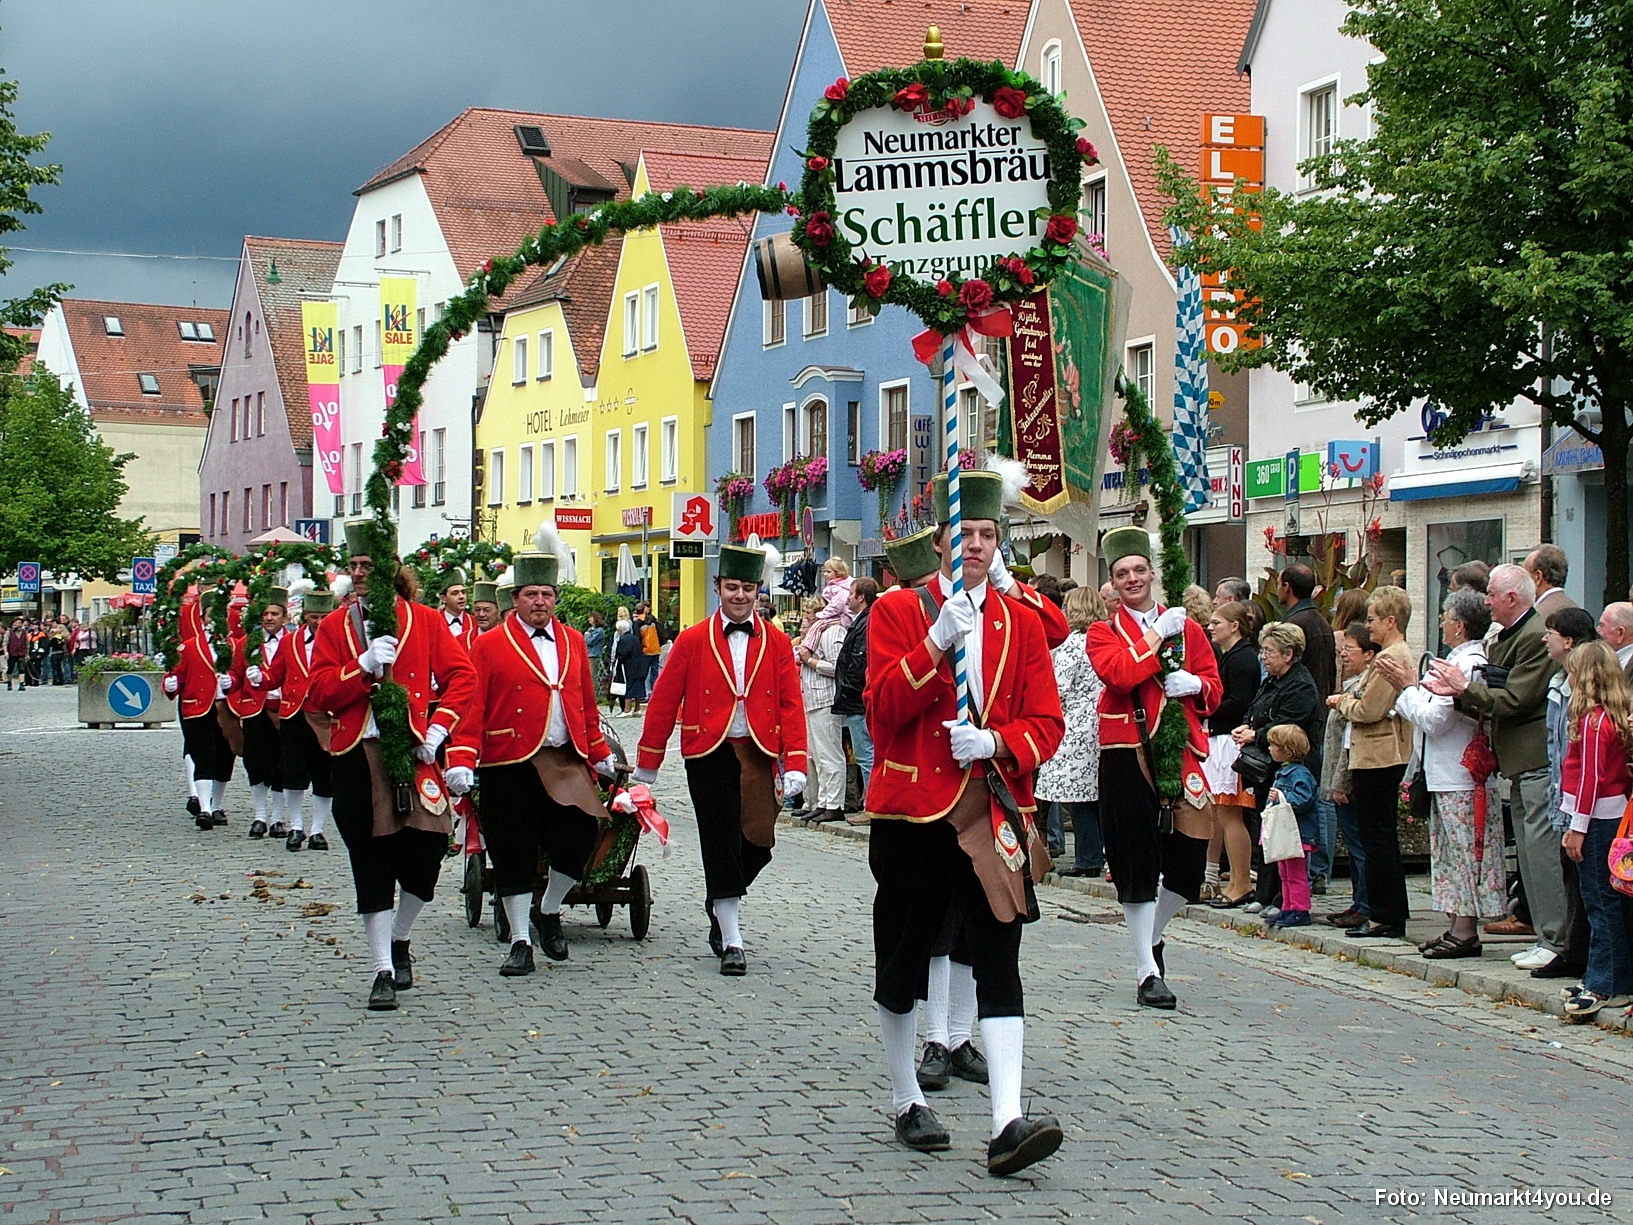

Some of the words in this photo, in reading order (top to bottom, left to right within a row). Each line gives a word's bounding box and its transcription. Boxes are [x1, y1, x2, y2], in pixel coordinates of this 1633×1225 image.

[863, 122, 1022, 155] Neumarkter
[834, 148, 1052, 193] Lammsbräu
[843, 197, 1041, 248] Schäffler
[384, 304, 413, 332] K&L
[384, 332, 413, 345] SALE
[526, 410, 553, 435] HOTEL
[559, 405, 590, 427] Lehmeier
[1433, 444, 1502, 460] Schnäppchenmarkt
[1232, 449, 1241, 518] KINO
[1256, 464, 1270, 485] 360
[556, 514, 592, 524] WISSMACH
[20, 582, 37, 590] TAXI
[135, 582, 154, 591] TAXI
